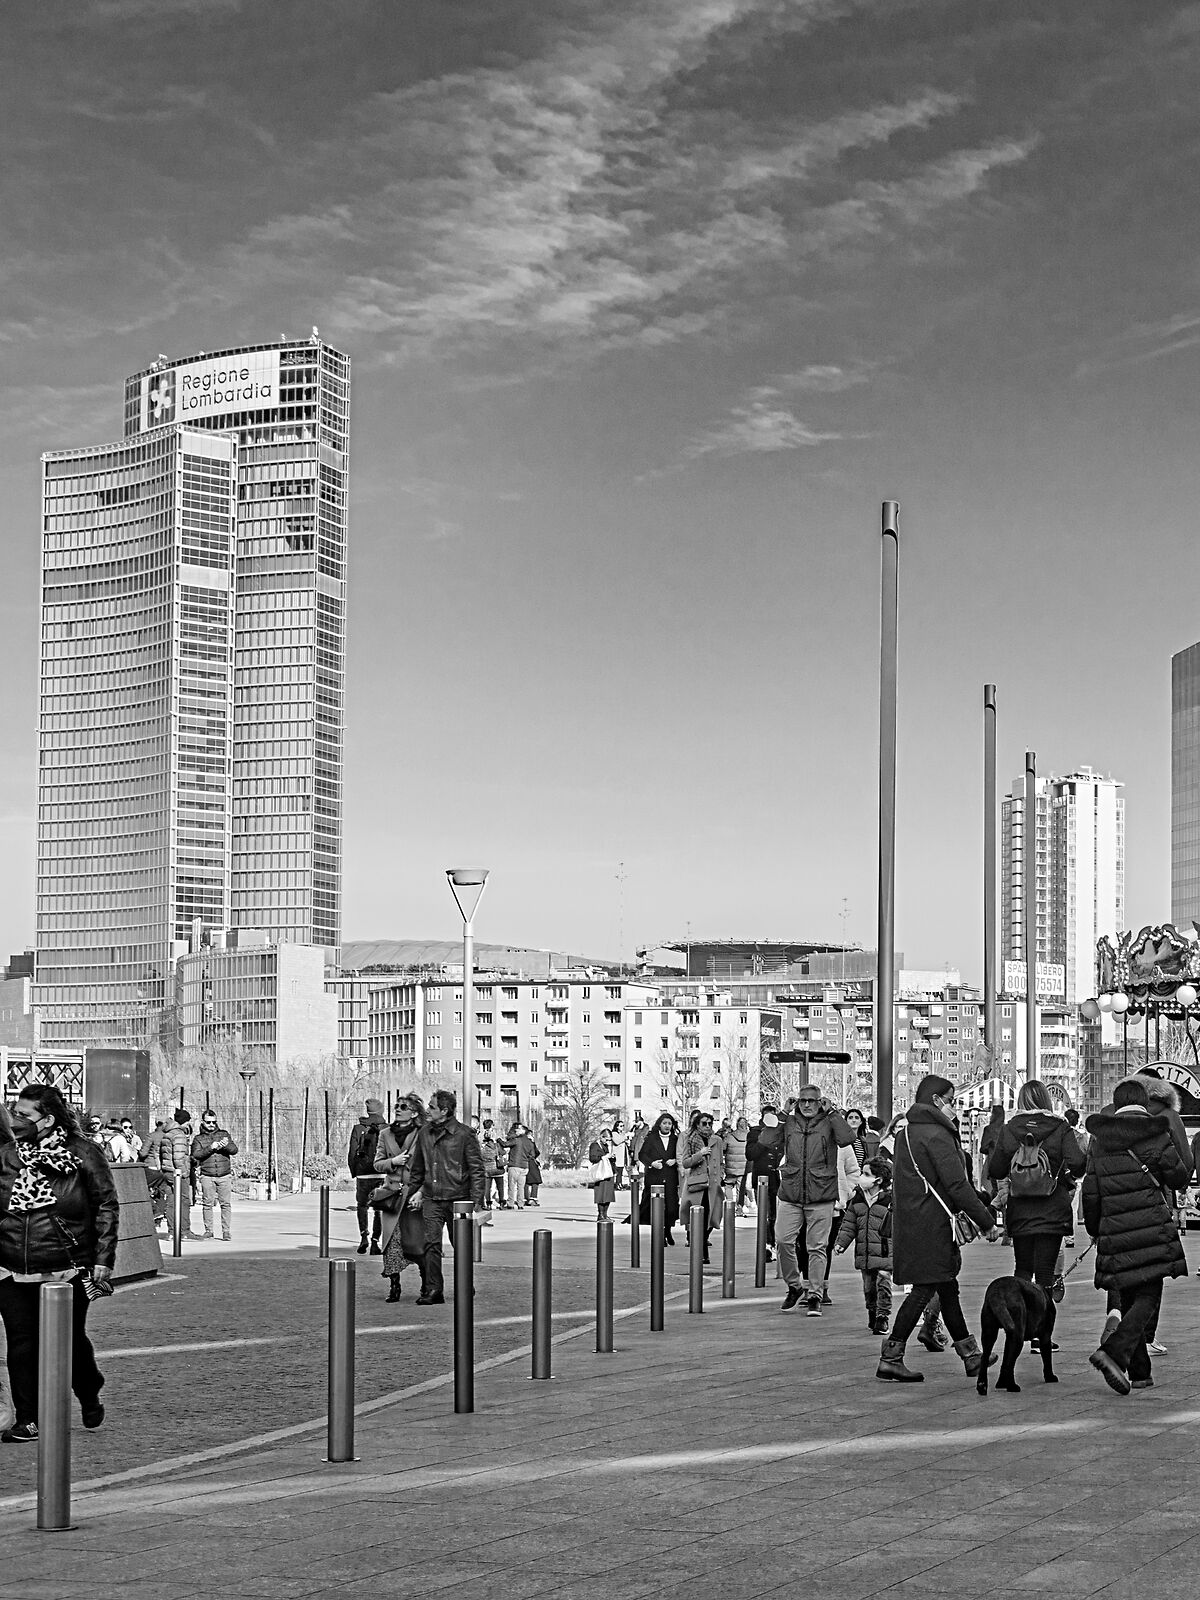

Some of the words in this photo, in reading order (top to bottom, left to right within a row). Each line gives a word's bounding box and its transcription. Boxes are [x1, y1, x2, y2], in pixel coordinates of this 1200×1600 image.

[182, 368, 249, 391] Regione
[182, 382, 271, 410] Lombardia
[1036, 964, 1063, 976] LIBERO
[1155, 1066, 1192, 1089] CITA
